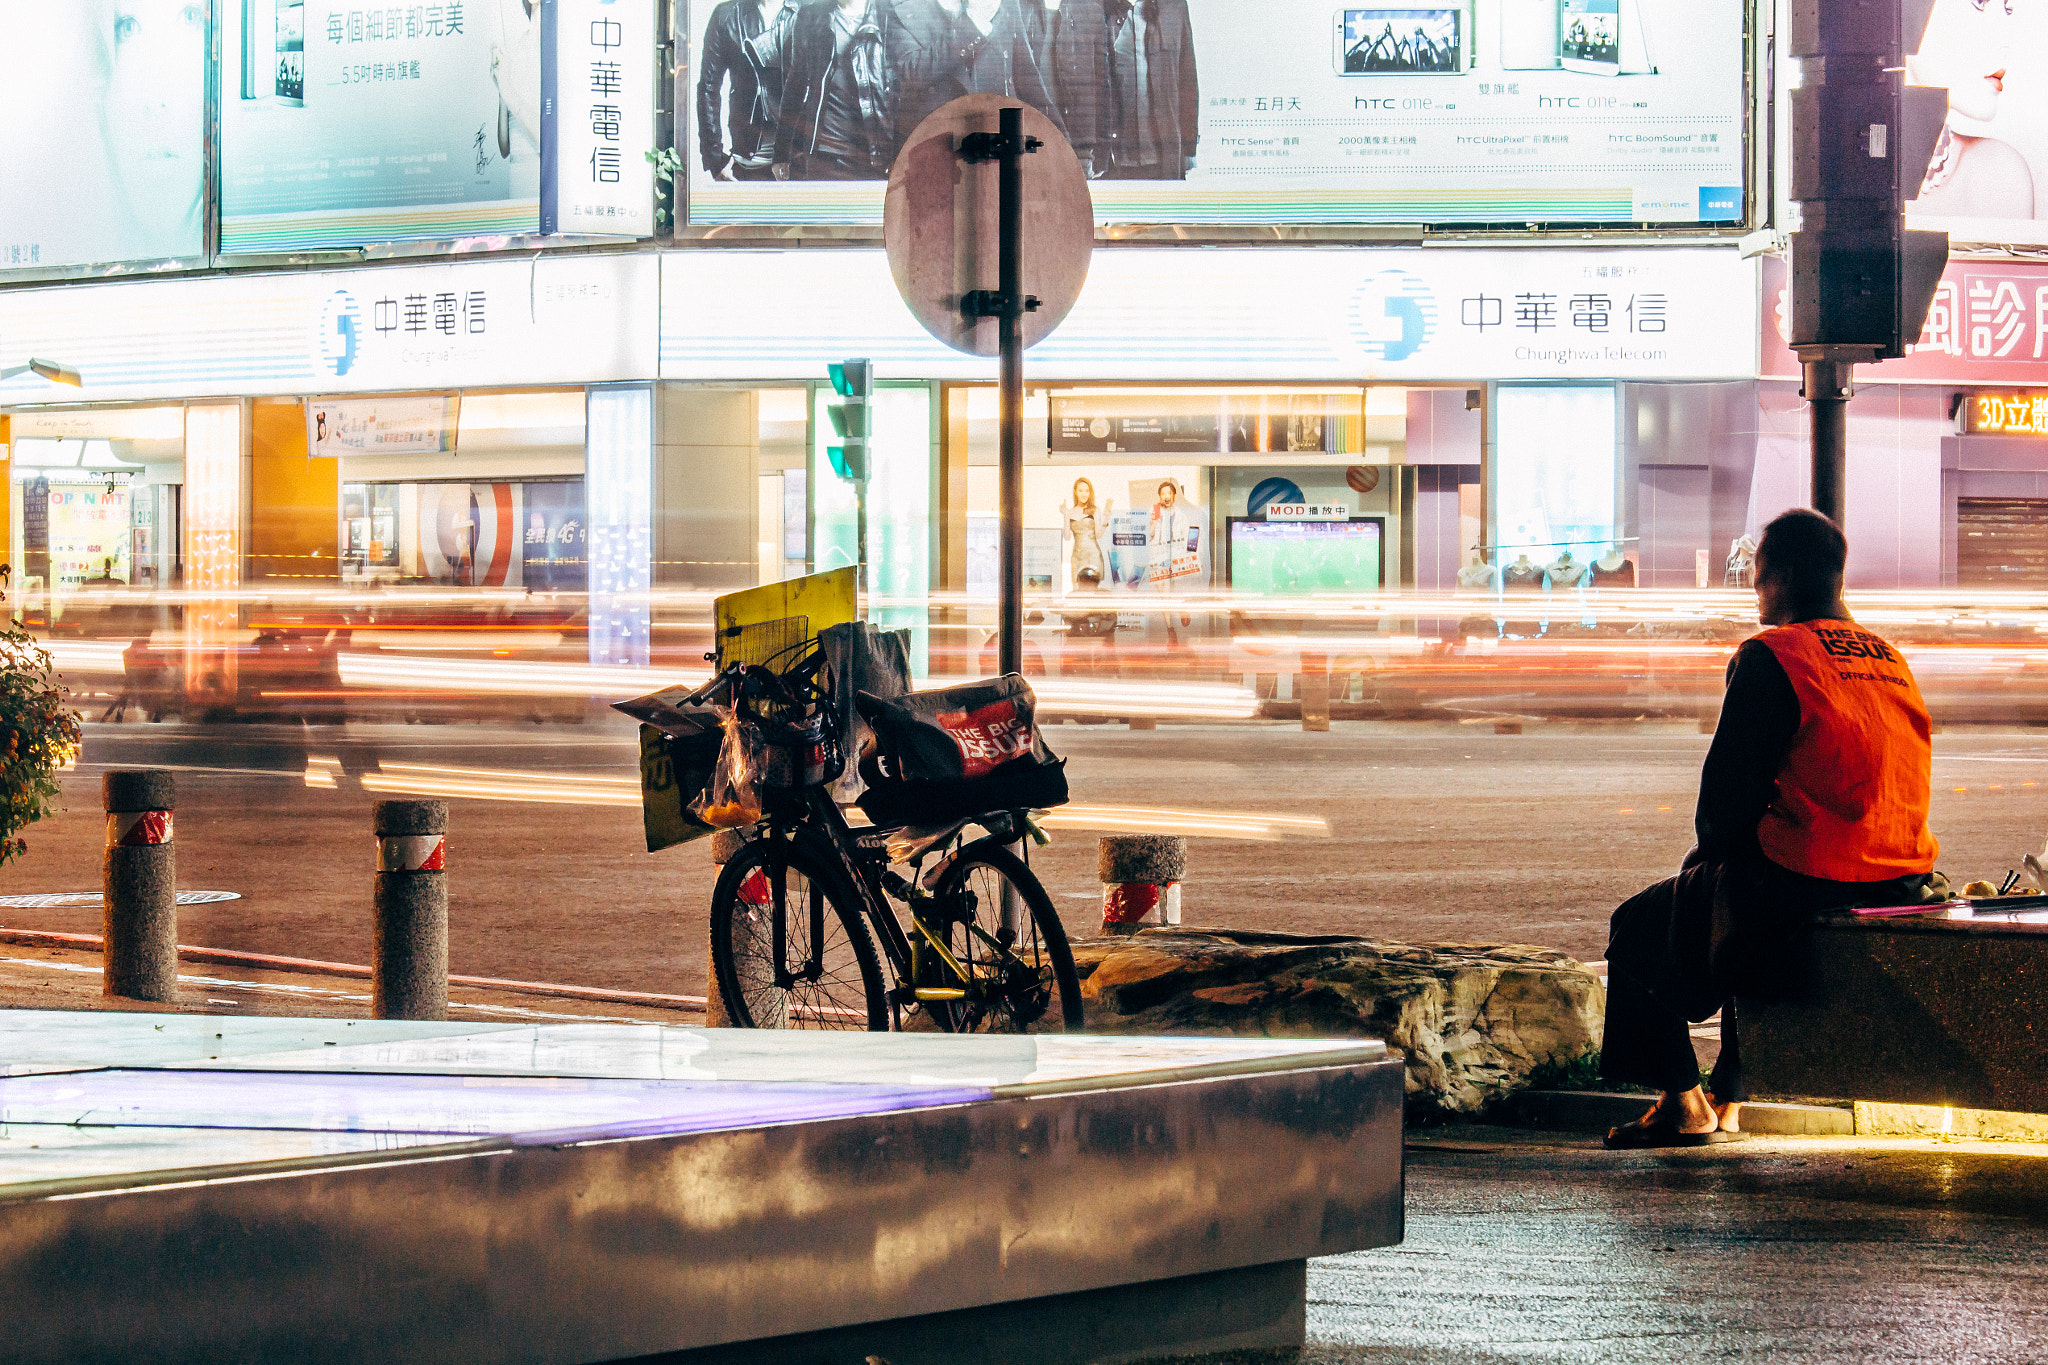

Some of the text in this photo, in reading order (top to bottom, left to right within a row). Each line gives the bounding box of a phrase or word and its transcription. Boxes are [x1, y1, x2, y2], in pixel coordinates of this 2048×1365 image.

[326, 1, 464, 44] 每個細節都完美
[342, 60, 421, 84] 5.5吋時尚旗艦
[590, 17, 622, 182] 中華電信
[1478, 83, 1519, 95] 雙旗艦
[1253, 96, 1302, 112] 五月天
[375, 290, 486, 338] 中華電信
[1461, 292, 1669, 334] 中華電信
[1514, 346, 1599, 365] Chunghwa
[1270, 505, 1346, 516] MOD 播放中
[1811, 628, 1856, 640] THE
[1819, 638, 1898, 665] ISSUE
[946, 717, 1021, 740] THE BIG
[957, 725, 1034, 759] ISSUE
